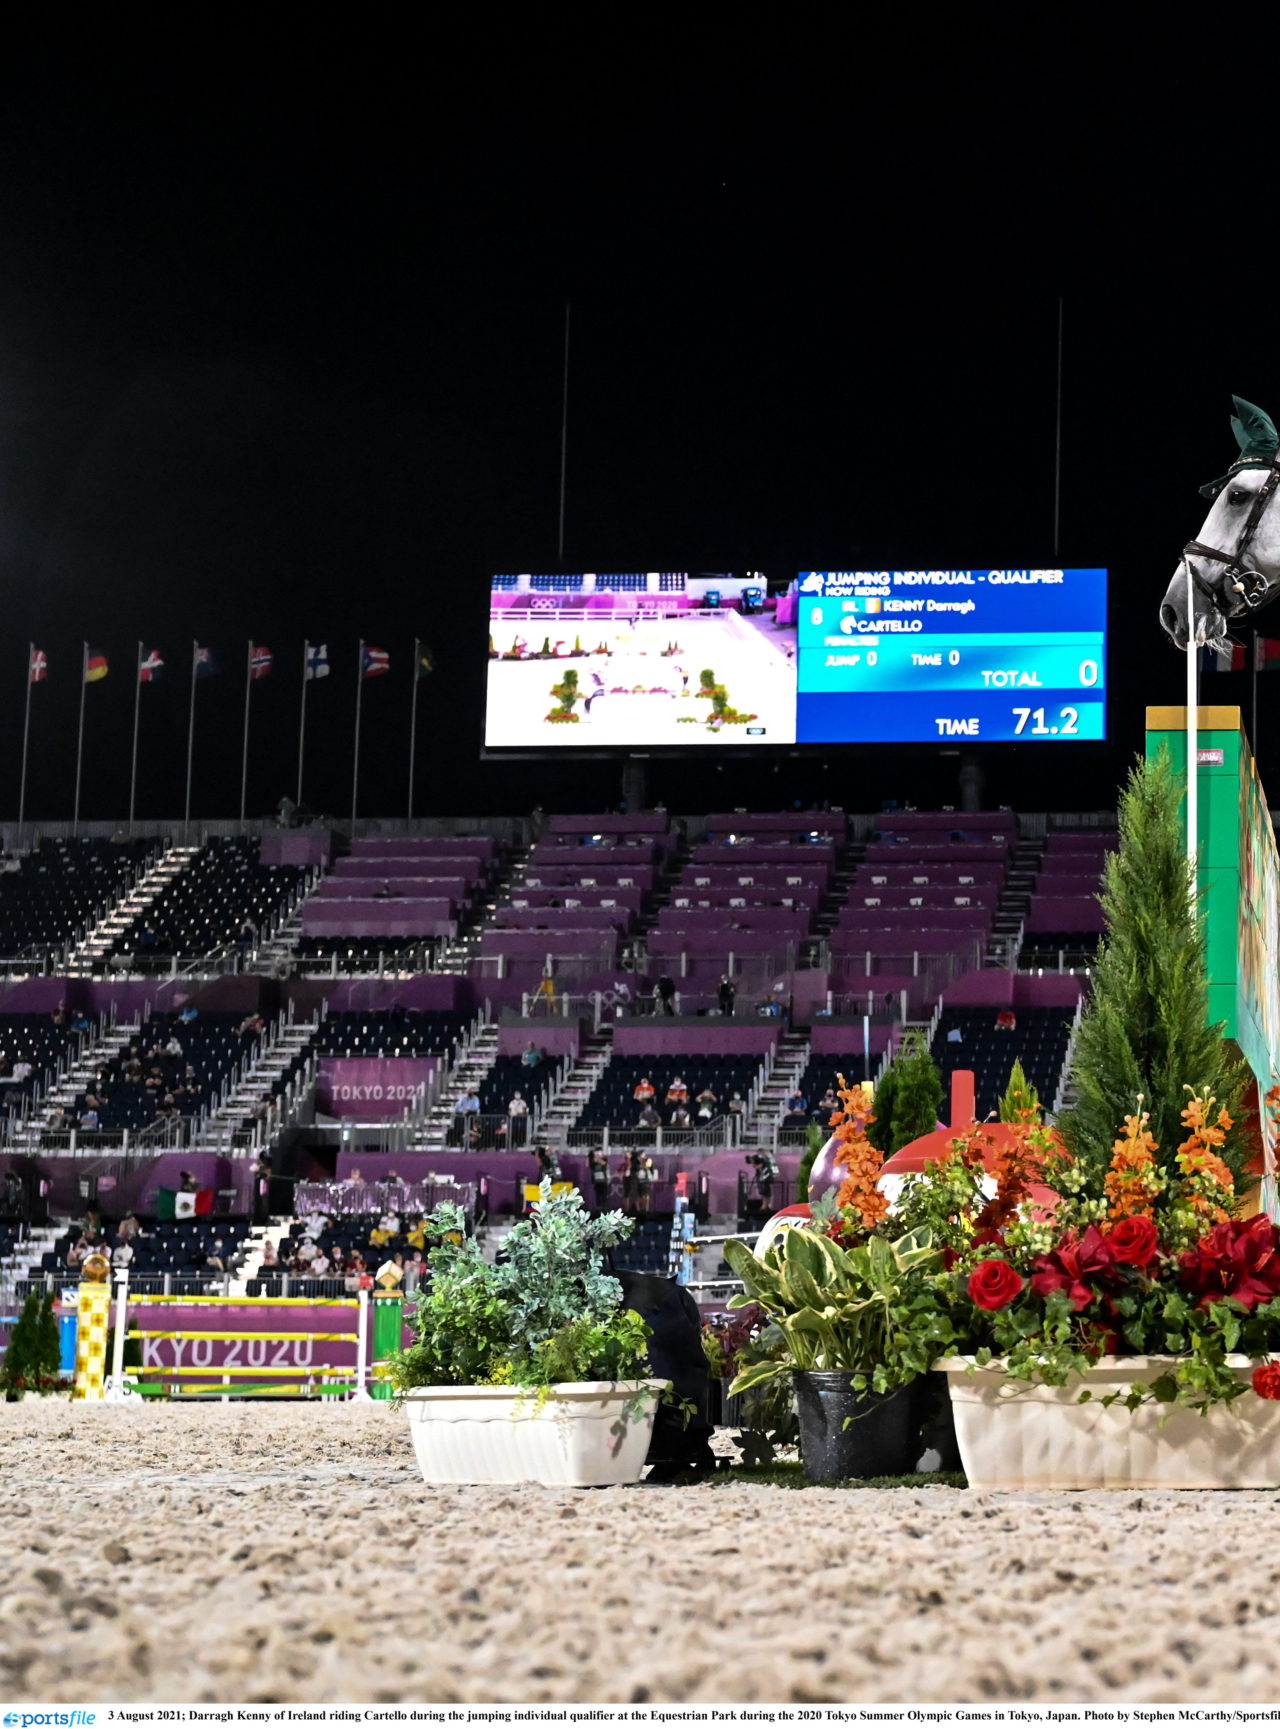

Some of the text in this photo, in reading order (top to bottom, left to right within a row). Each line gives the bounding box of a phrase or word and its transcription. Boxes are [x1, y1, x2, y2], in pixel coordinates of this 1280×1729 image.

[825, 572, 891, 586] JUMPING
[894, 571, 975, 585] INDIVIDUAL
[987, 570, 1064, 584] QUALIFIER
[825, 586, 891, 596] NOW RIDING
[883, 599, 976, 614] KENNY Darragh
[857, 619, 923, 633] CARTELLO
[825, 650, 878, 667] JUMP 0
[911, 649, 960, 666] TIME 0
[981, 659, 1099, 687] TOTAL 0
[935, 706, 1079, 735] TIME 71.2
[331, 1085, 383, 1101] TOKYO
[143, 1338, 313, 1368] KYO 2020
